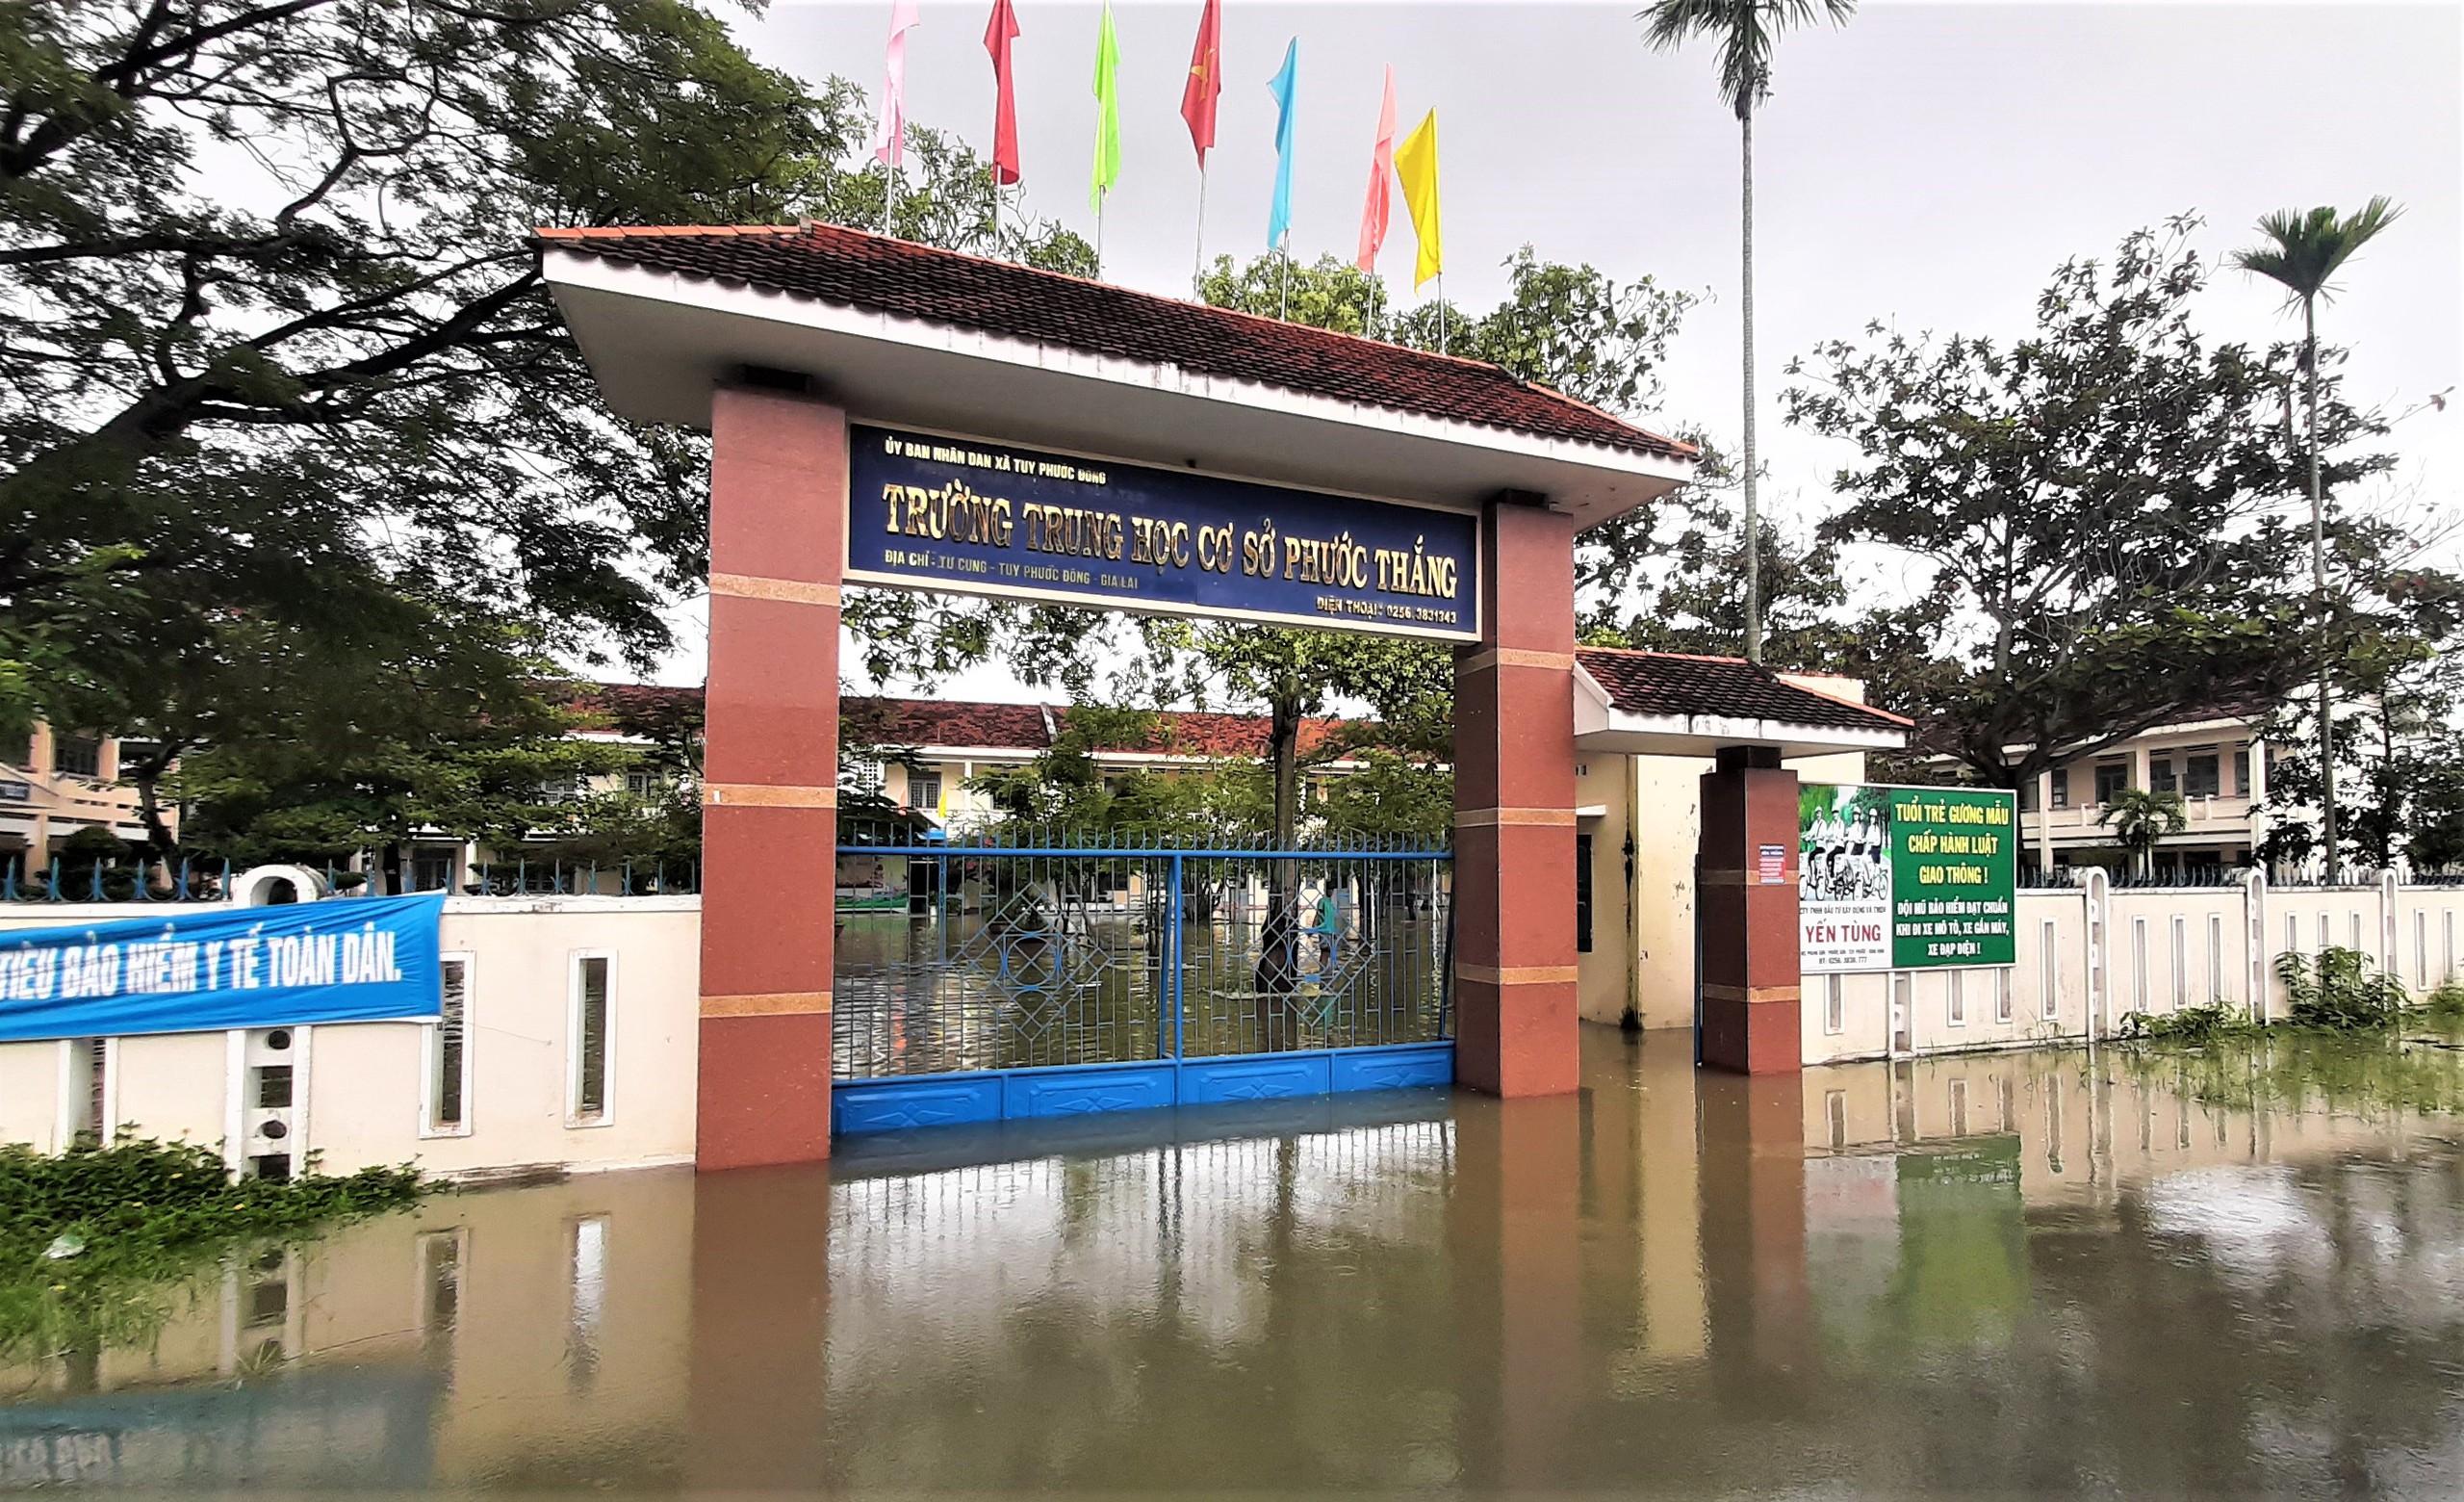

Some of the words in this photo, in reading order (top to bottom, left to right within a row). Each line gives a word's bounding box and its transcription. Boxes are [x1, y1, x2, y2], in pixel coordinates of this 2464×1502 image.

[905, 442, 931, 459] BAN
[933, 447, 965, 464] NHÂN
[1013, 458, 1036, 475] TUY
[882, 478, 1014, 548] TRƯỜNG
[1022, 503, 1124, 559] TRUNG
[1131, 516, 1190, 576] HỌC
[1197, 522, 1234, 574] CƠ
[1243, 517, 1277, 579] SỞ
[1283, 531, 1368, 590] PHƯỚC
[1374, 534, 1458, 599] THẮNG
[886, 549, 906, 566] ĐỊA
[999, 562, 1020, 577] TUY
[1100, 574, 1117, 587] GIA
[1121, 576, 1138, 589] LAI
[1895, 795, 1922, 822] TUỔI
[1924, 798, 1946, 822] TRẺ
[1949, 802, 1984, 824] GƯƠNG
[1986, 799, 2009, 824] MẪU
[1908, 829, 1938, 853] CHẤP
[1940, 831, 1969, 853] HÀNH
[1971, 832, 1998, 858] LUẬT
[1919, 866, 1944, 884] GIAO
[1946, 862, 1982, 884] THÔNG
[1806, 918, 1835, 944] YẾN
[1840, 919, 1881, 943] TÙNG
[1896, 922, 1911, 936] KHI
[1912, 922, 1921, 936] ĐI
[1922, 922, 1933, 935] XE
[1963, 921, 1973, 934] XE
[62, 930, 120, 997] BẢO
[127, 922, 199, 995] HIỂM
[205, 941, 223, 991] Y
[229, 921, 264, 989] TẾ
[267, 925, 336, 988] TOÀN
[343, 921, 402, 984] DÂN.
[1928, 944, 1938, 956] XE
